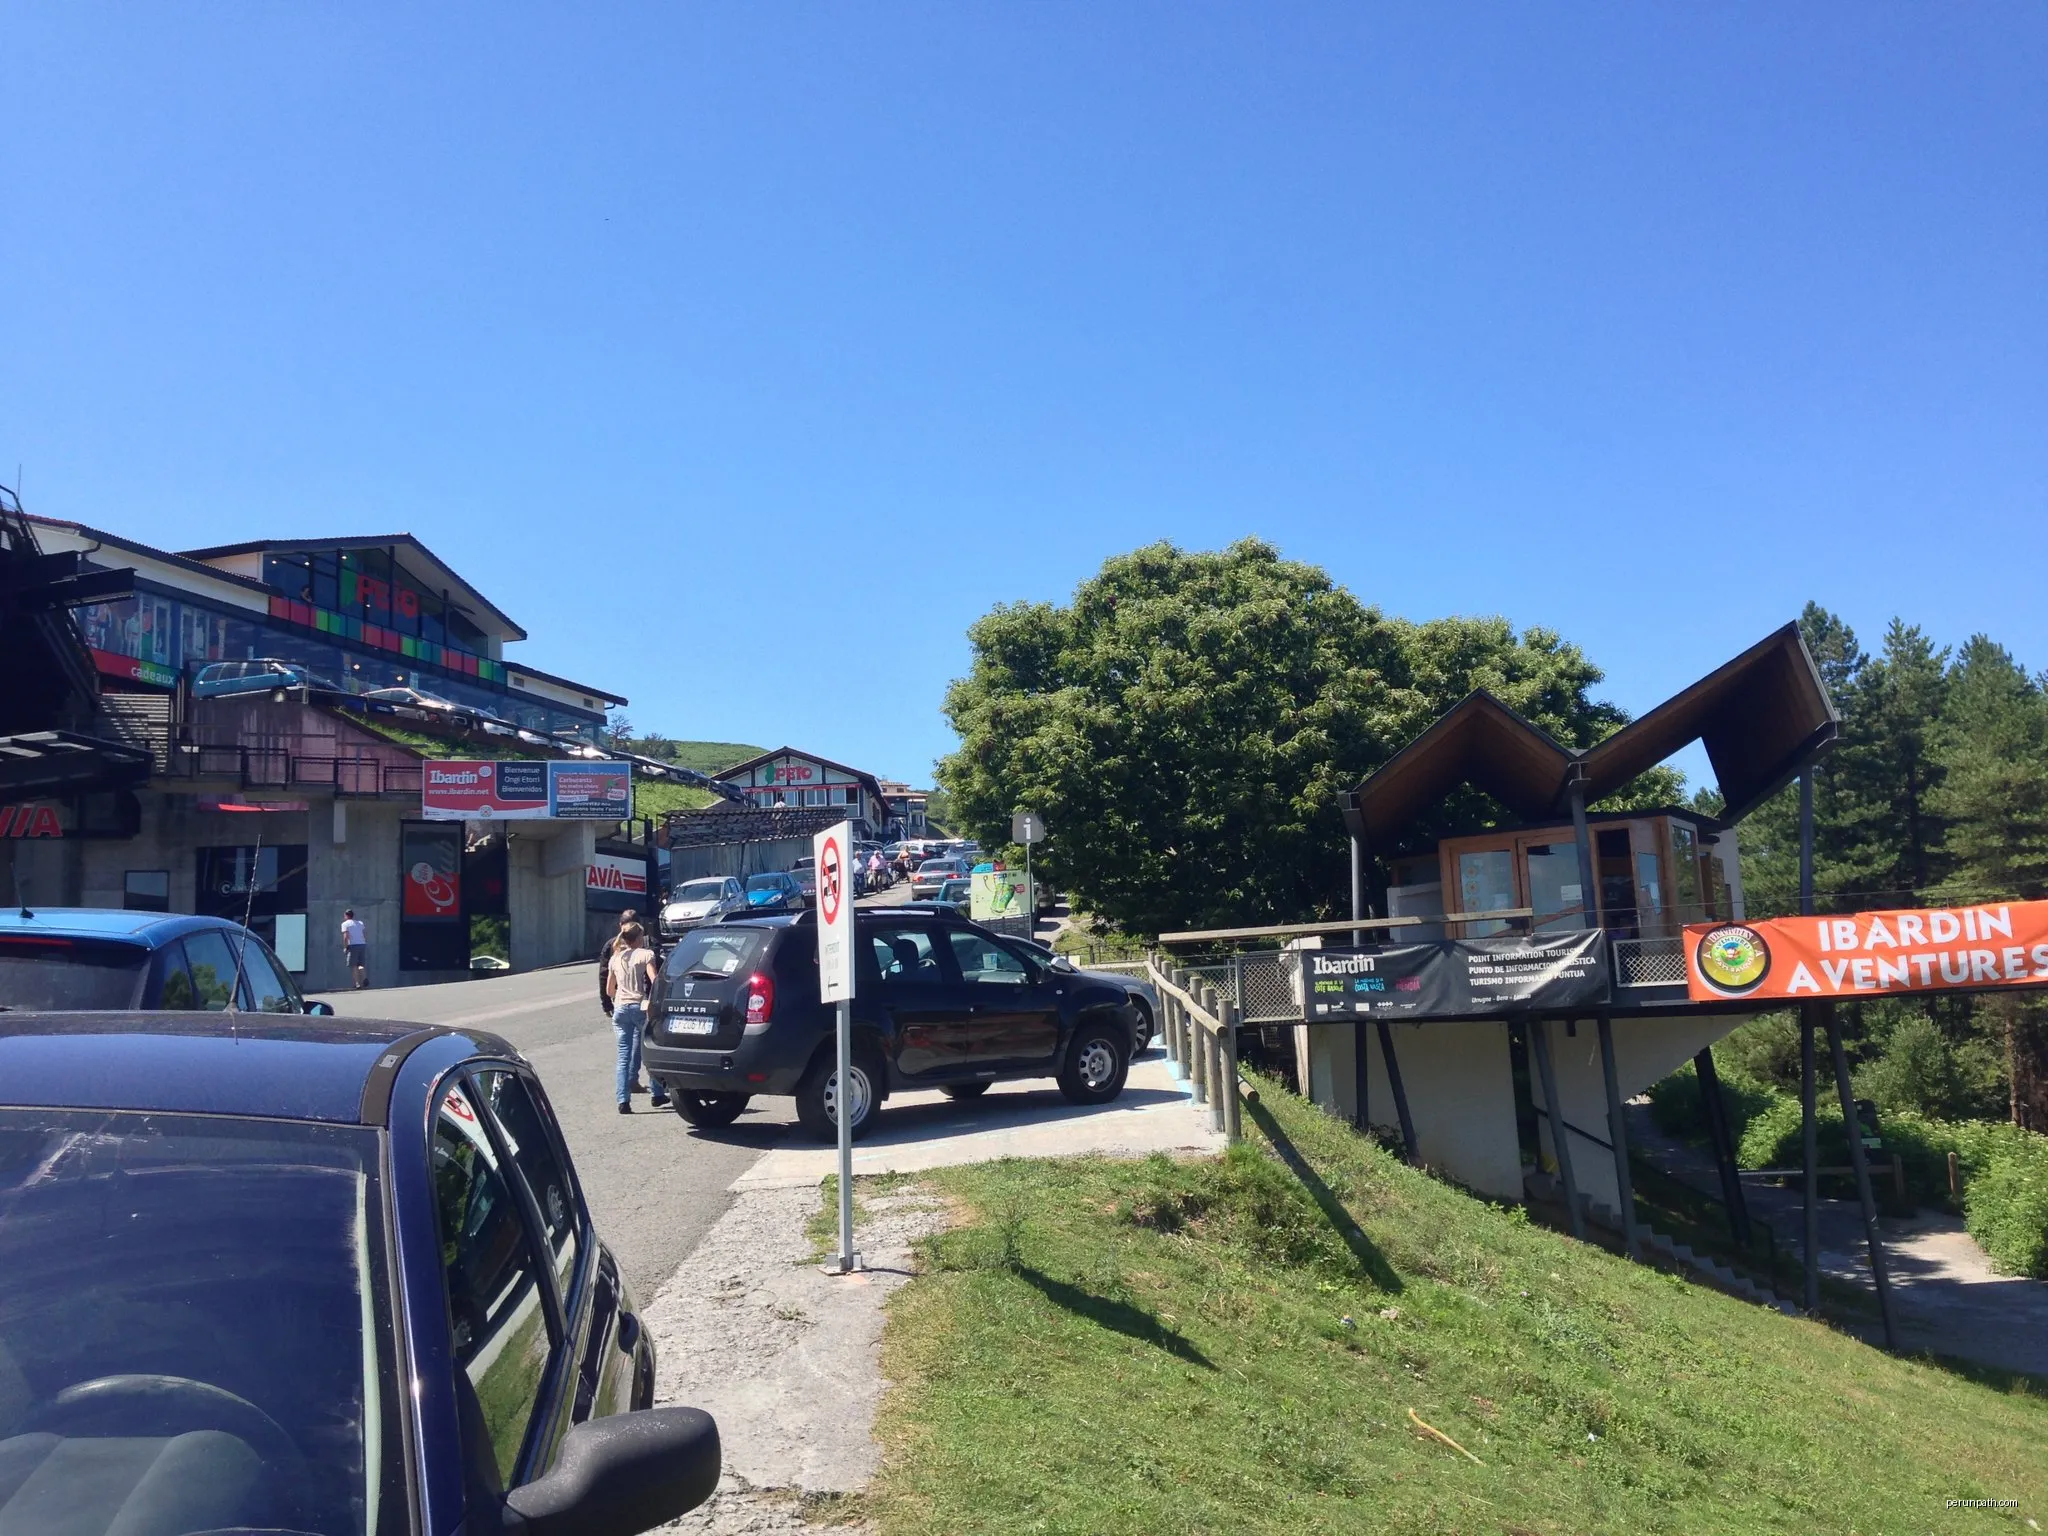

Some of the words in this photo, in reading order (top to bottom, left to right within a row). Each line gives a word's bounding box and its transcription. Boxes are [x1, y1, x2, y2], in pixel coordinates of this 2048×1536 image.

[131, 667, 175, 685] cadeaux
[504, 766, 540, 774] Bienvenue
[430, 770, 478, 785] Ibardin
[502, 785, 543, 793] Bienvenidos
[588, 864, 623, 889] AVIA
[1817, 906, 2012, 951] IBARDIN
[1468, 954, 1491, 963] POINT
[1492, 950, 1546, 962] INFORMATION
[1313, 954, 1375, 975] Ibardin
[1468, 966, 1493, 975] PUNTO
[1494, 965, 1505, 973] DE
[1786, 943, 2048, 994] AVENTURES
[1469, 977, 1503, 986] TURISMO
[668, 1005, 707, 1014] DUSTER
